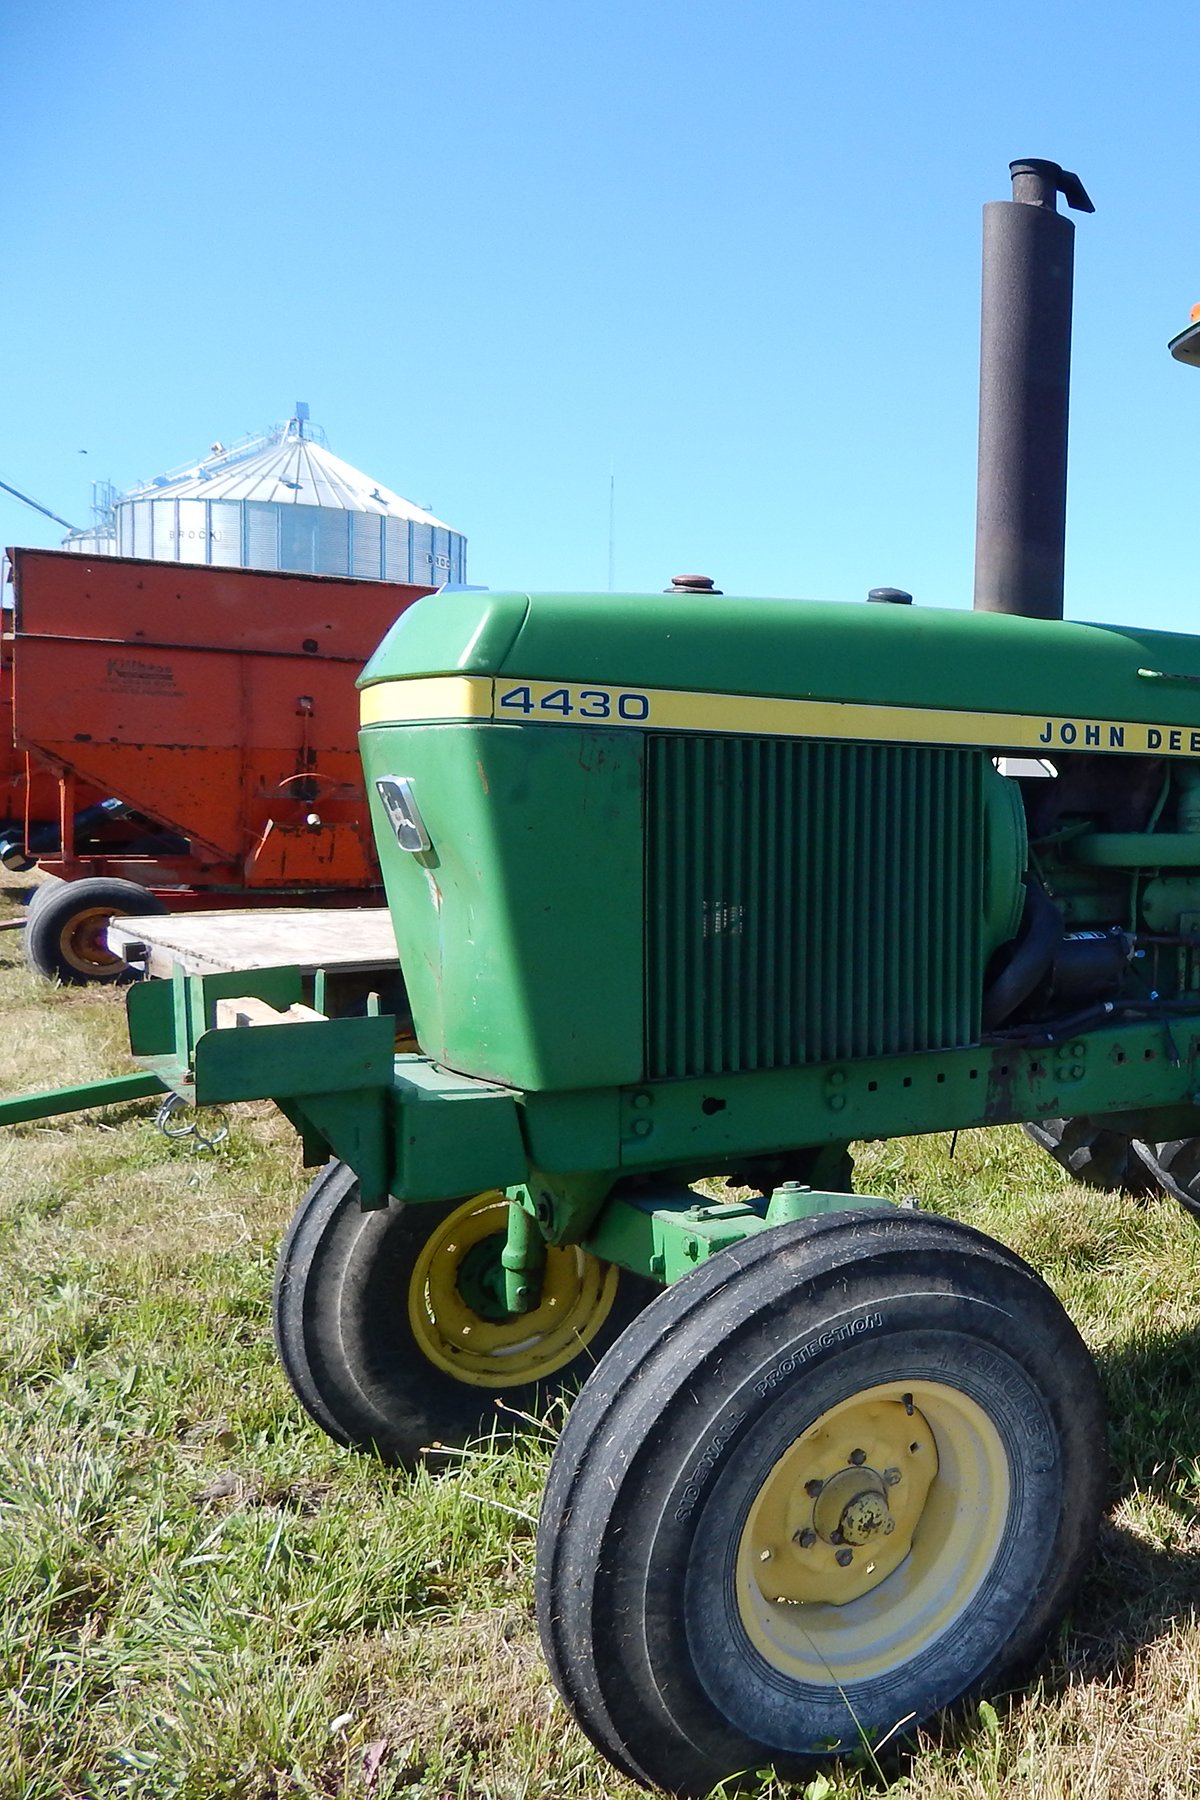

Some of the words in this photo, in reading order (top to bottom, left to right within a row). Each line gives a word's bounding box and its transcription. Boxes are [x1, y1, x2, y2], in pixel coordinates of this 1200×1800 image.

[169, 530, 217, 541] BROCK
[427, 554, 453, 568] BROC
[500, 686, 649, 720] 4430
[1039, 722, 1124, 747] JOHN
[674, 1409, 746, 1523] SIDEWALL
[753, 1312, 883, 1398] PROTECTION
